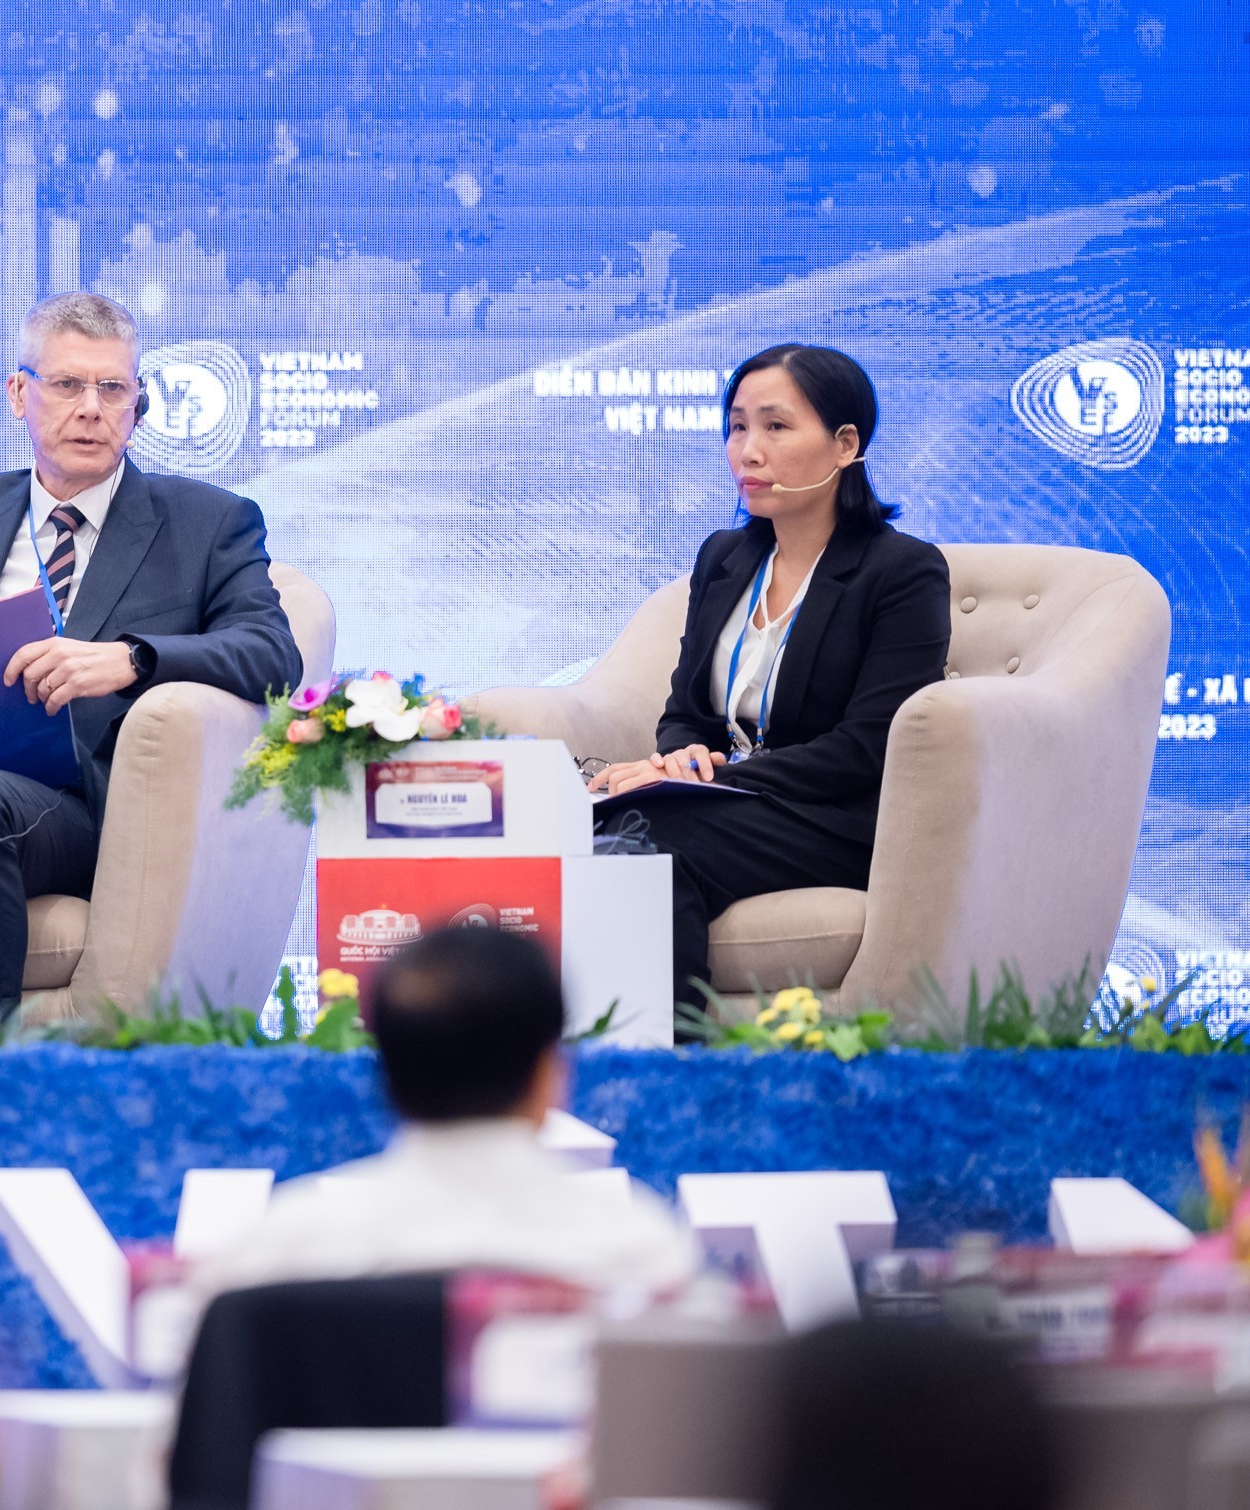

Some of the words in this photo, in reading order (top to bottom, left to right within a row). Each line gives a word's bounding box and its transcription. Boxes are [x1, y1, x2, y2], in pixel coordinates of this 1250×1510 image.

[260, 351, 364, 371] VIETNAM
[1174, 348, 1250, 368] VIETNA
[260, 372, 328, 390] SOCIO
[657, 369, 716, 397] KINH
[1174, 368, 1242, 387] SOCIO
[260, 391, 378, 409] ECONOMIC
[1174, 388, 1250, 404] ECONO
[260, 410, 341, 427] FORUM
[605, 401, 658, 436] VIỆT
[664, 405, 723, 432] NAM
[260, 430, 316, 447] 2023
[1174, 426, 1229, 444] 2023
[1204, 674, 1238, 704] XÃ
[1158, 714, 1217, 740] 2023
[500, 907, 534, 916] VIETNAM
